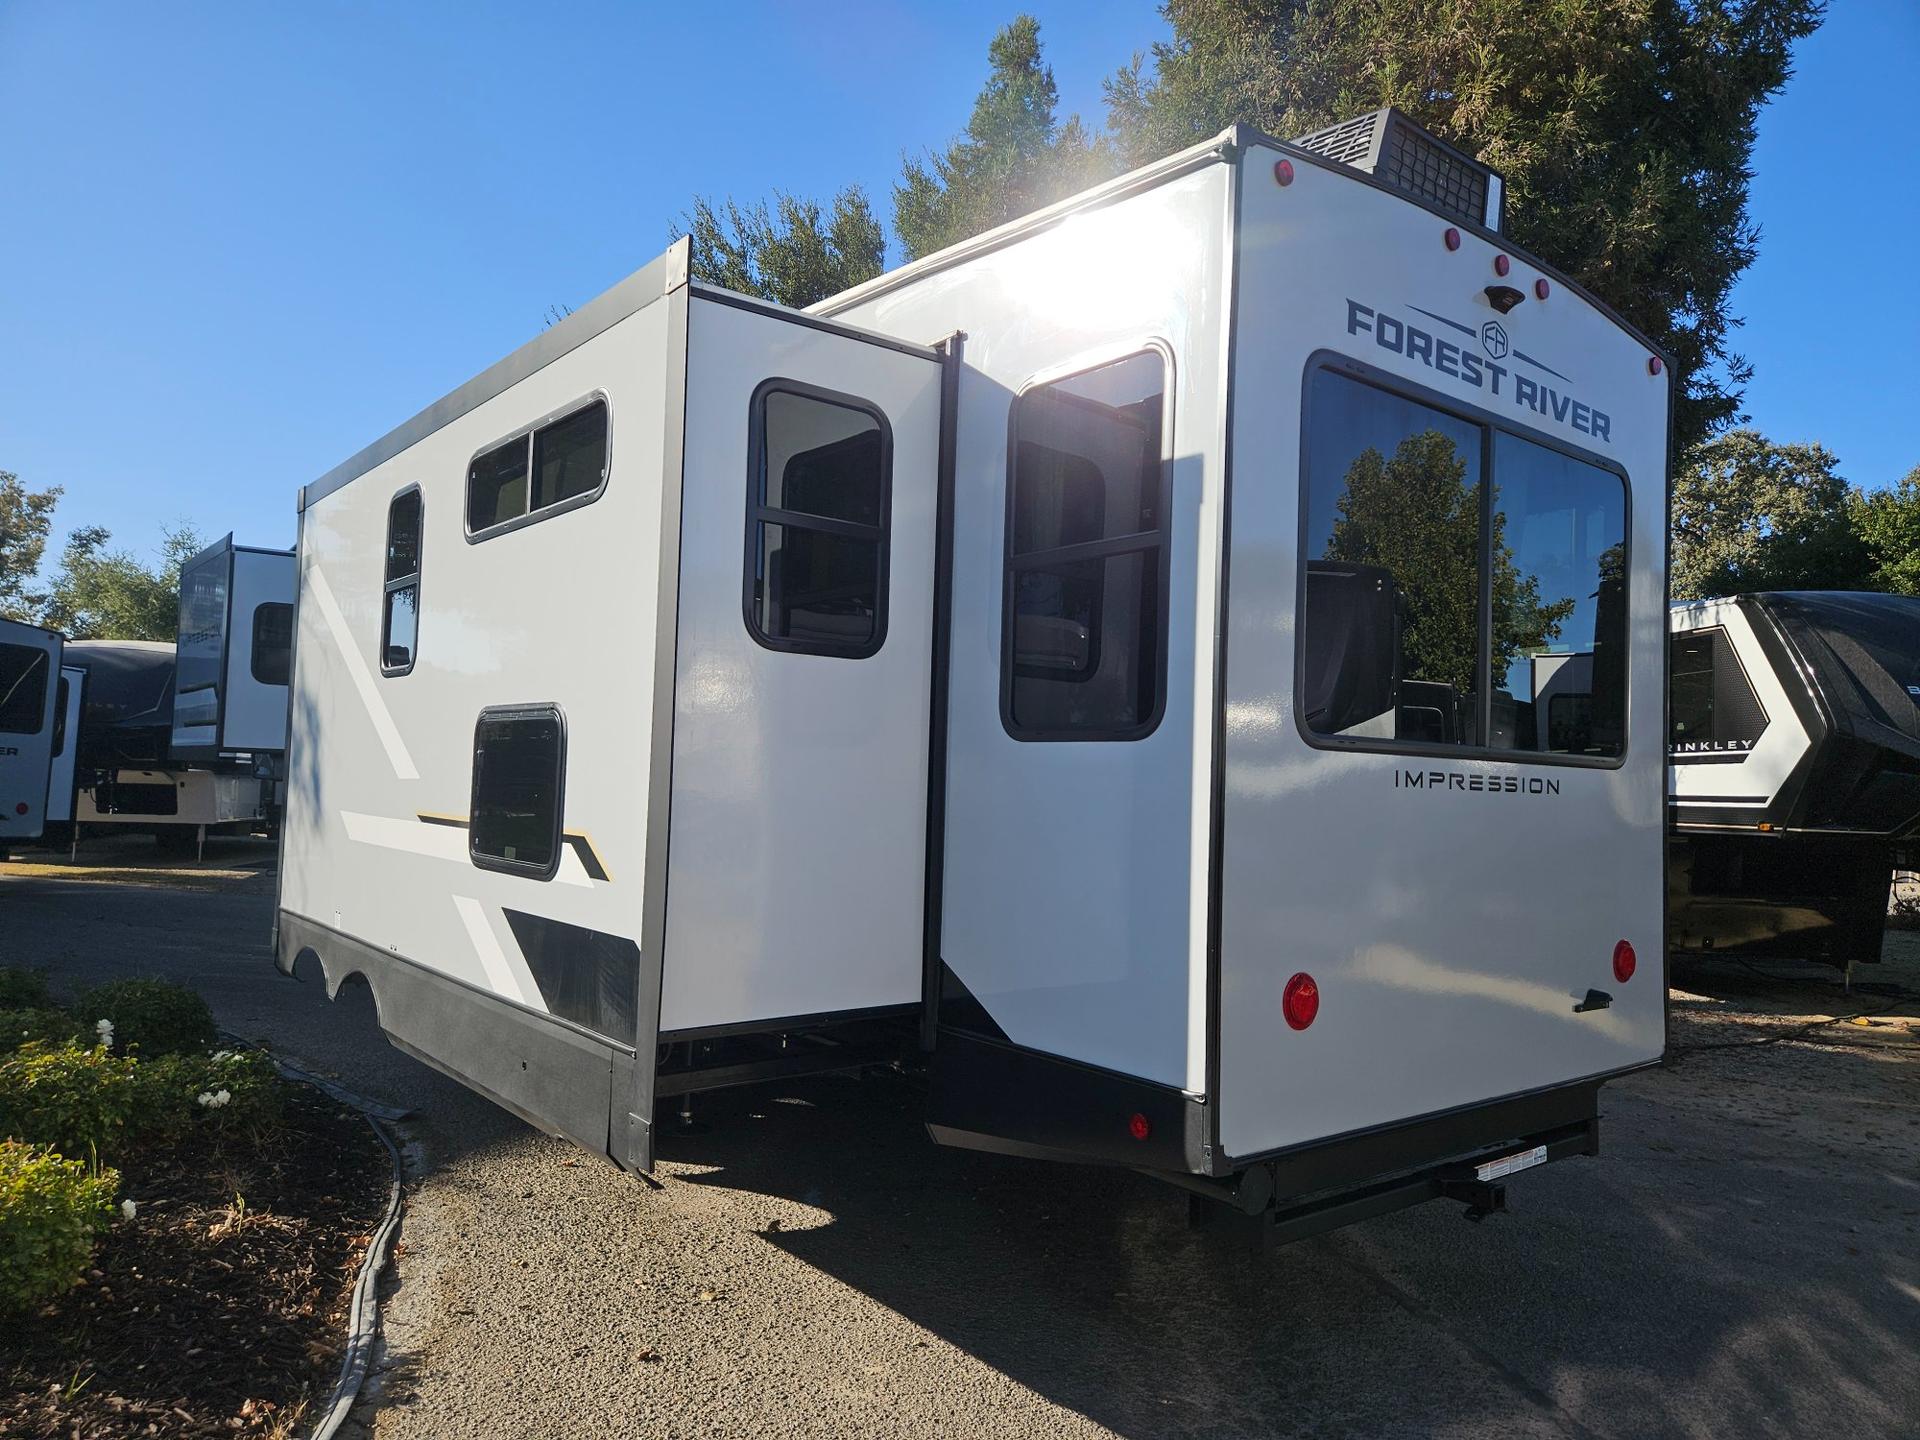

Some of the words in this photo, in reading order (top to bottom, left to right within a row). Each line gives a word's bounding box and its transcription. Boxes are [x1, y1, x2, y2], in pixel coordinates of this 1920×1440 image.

[1346, 298, 1507, 395] FOREST
[1515, 373, 1611, 443] RIVER
[1395, 770, 1560, 795] IMPRESSION
